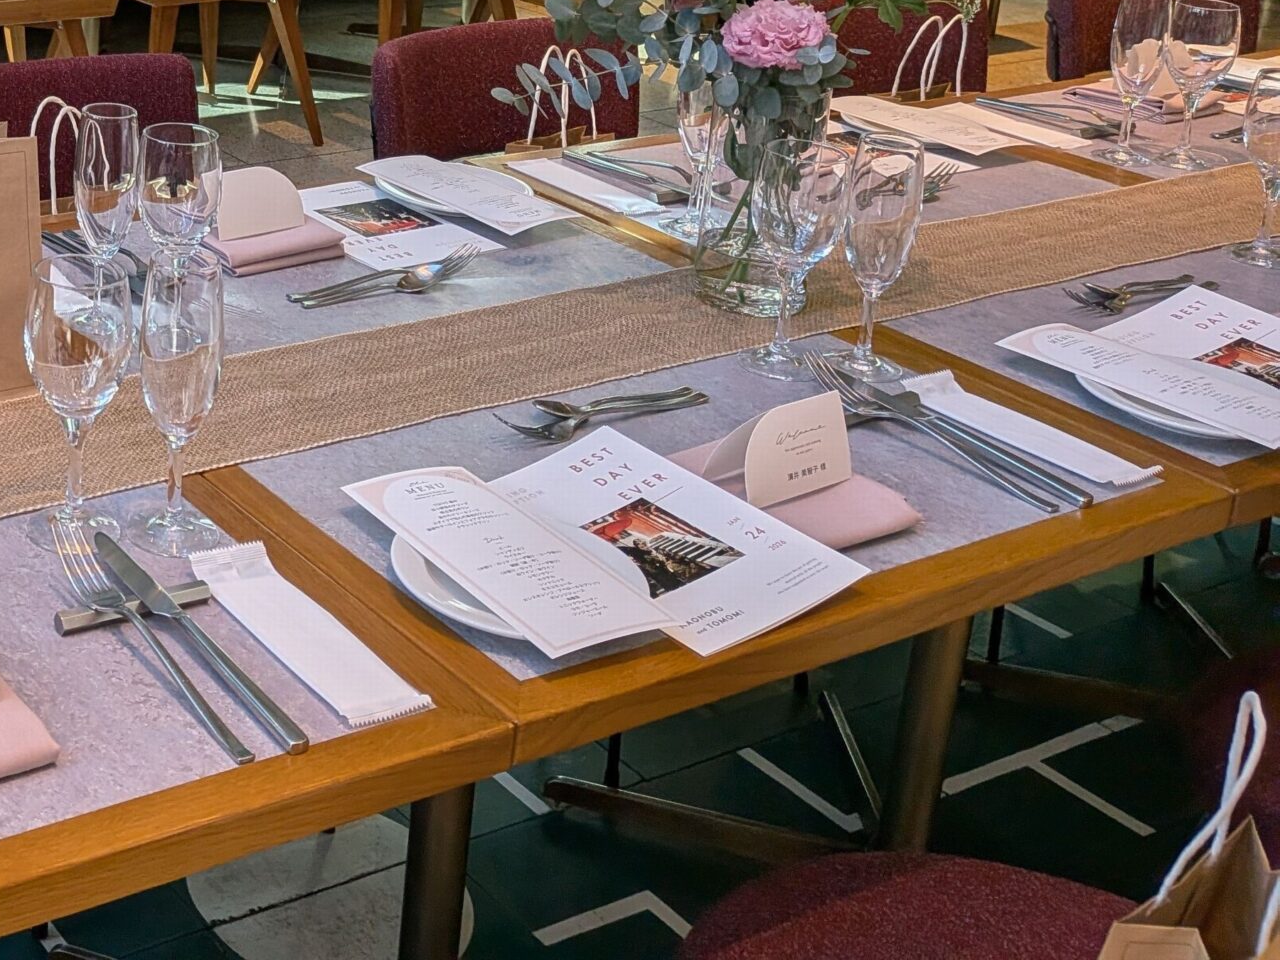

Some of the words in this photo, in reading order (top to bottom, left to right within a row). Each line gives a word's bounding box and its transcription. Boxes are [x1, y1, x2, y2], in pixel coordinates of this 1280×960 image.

[1169, 300, 1207, 320] BEST
[1194, 312, 1229, 330] DAY
[1220, 319, 1262, 340] EVER
[568, 447, 614, 474] BEST
[592, 462, 633, 487] DAY
[405, 482, 445, 495] MENU
[617, 472, 668, 501] EVER
[744, 526, 766, 541] 24
[706, 609, 745, 629] TOMOMI
